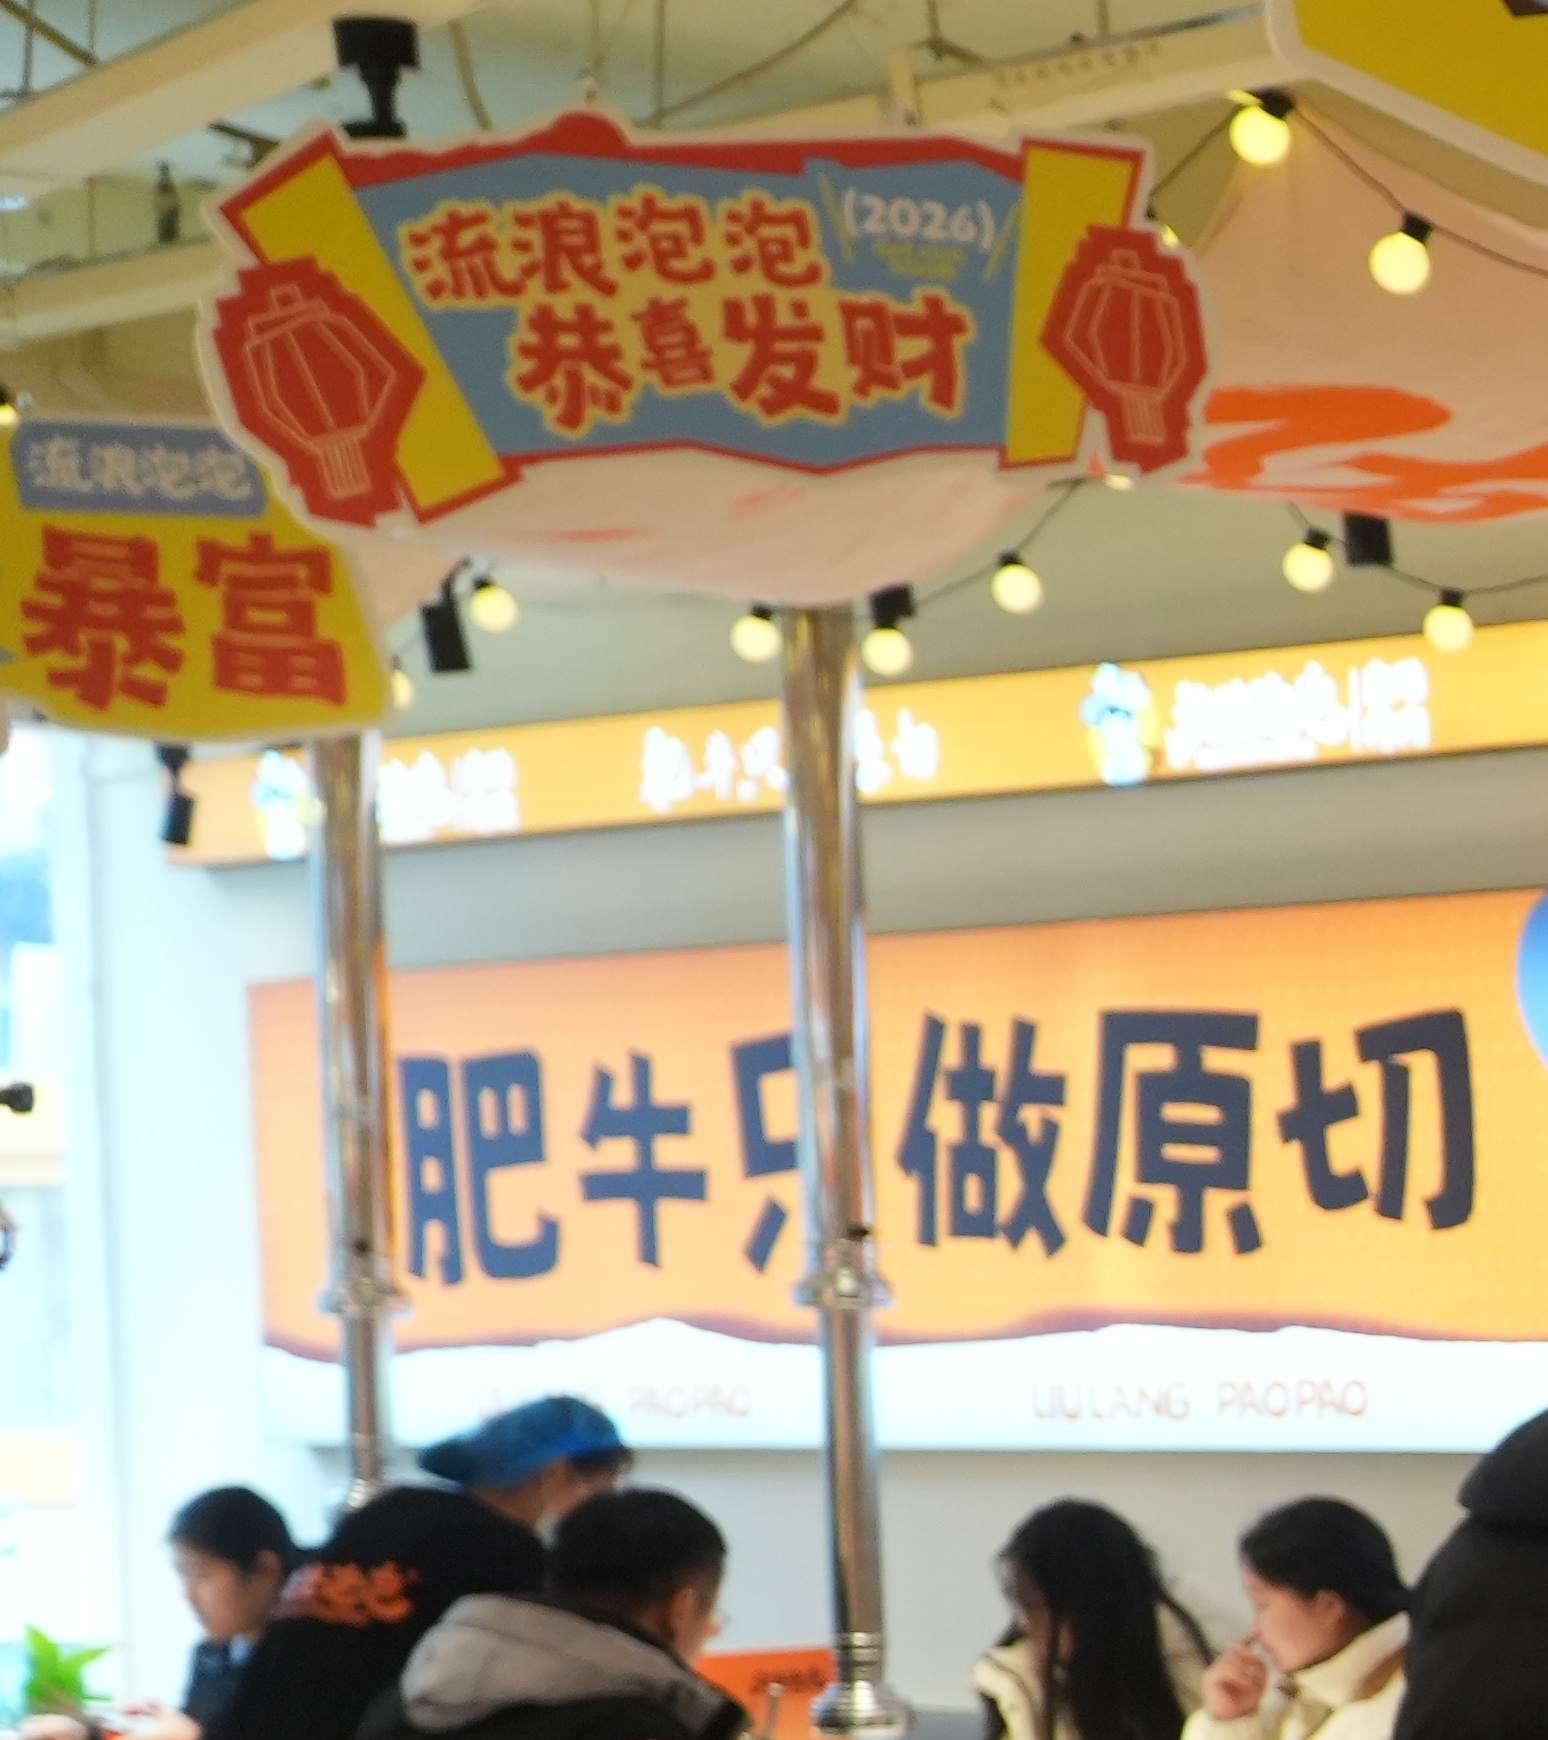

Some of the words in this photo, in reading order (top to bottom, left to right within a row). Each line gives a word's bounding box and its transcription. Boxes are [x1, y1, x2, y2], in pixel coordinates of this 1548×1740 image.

[407, 193, 824, 299] 流浪泡泡
[516, 293, 972, 432] 恭喜发财
[20, 523, 348, 712] 暴富
